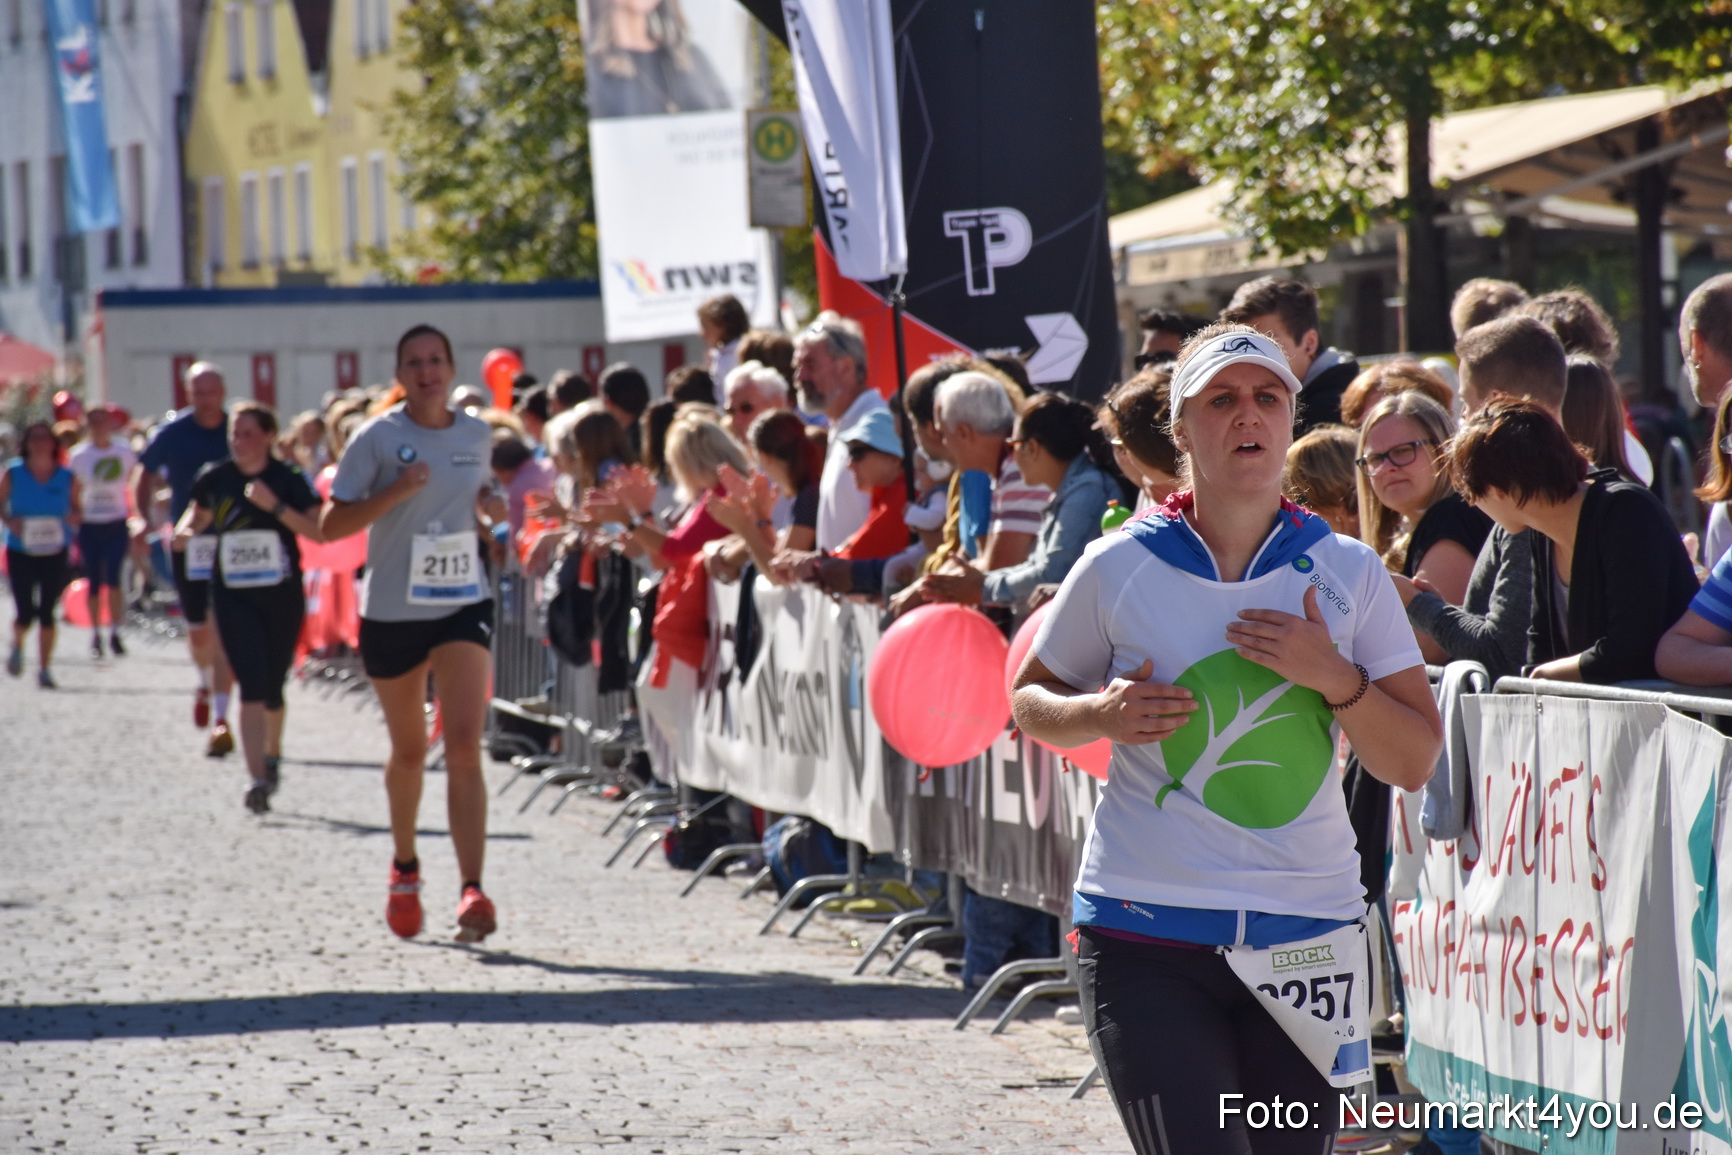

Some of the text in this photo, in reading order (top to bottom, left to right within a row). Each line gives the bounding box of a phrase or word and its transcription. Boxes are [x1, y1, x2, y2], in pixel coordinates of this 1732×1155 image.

[423, 554, 471, 577] 2113
[1309, 573, 1351, 616] Bionorica
[1272, 944, 1335, 968] BOCK
[1272, 966, 1294, 975] inspired
[1301, 963, 1316, 971] smart
[1316, 960, 1337, 969] concepts
